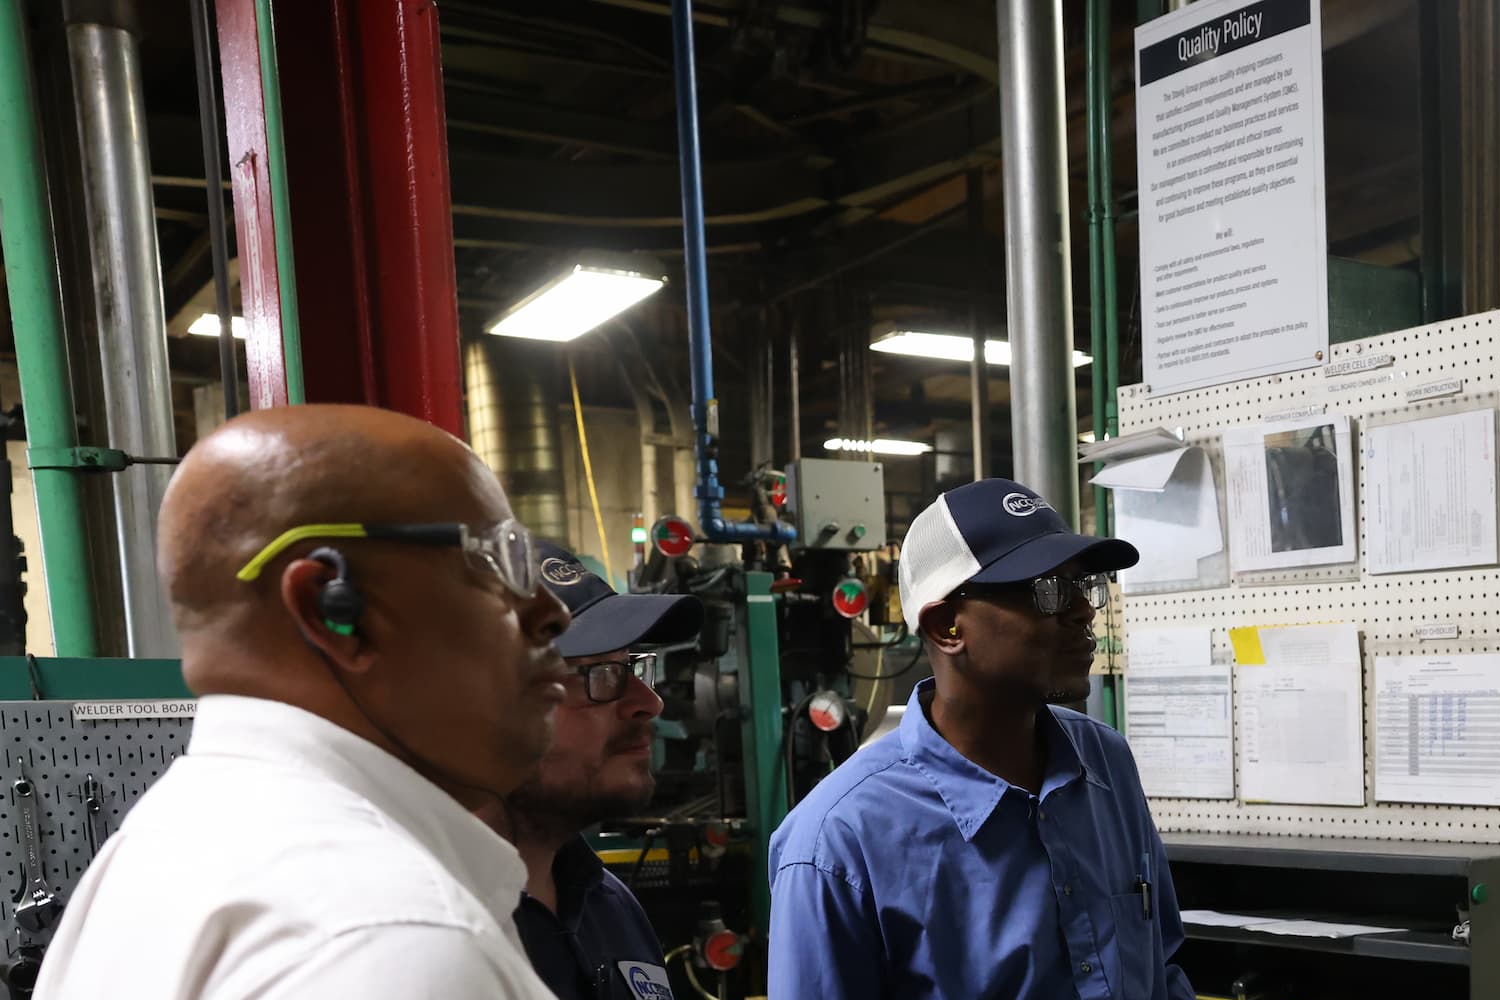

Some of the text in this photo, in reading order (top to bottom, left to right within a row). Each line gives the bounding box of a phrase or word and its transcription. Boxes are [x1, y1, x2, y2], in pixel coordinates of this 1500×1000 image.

[1178, 12, 1263, 62] Quality Policy
[1324, 354, 1390, 375] WELDER CELL BOARD
[1423, 381, 1459, 394] INSTRUCTIONS
[74, 703, 198, 715] WELDER TOOL BOAR
